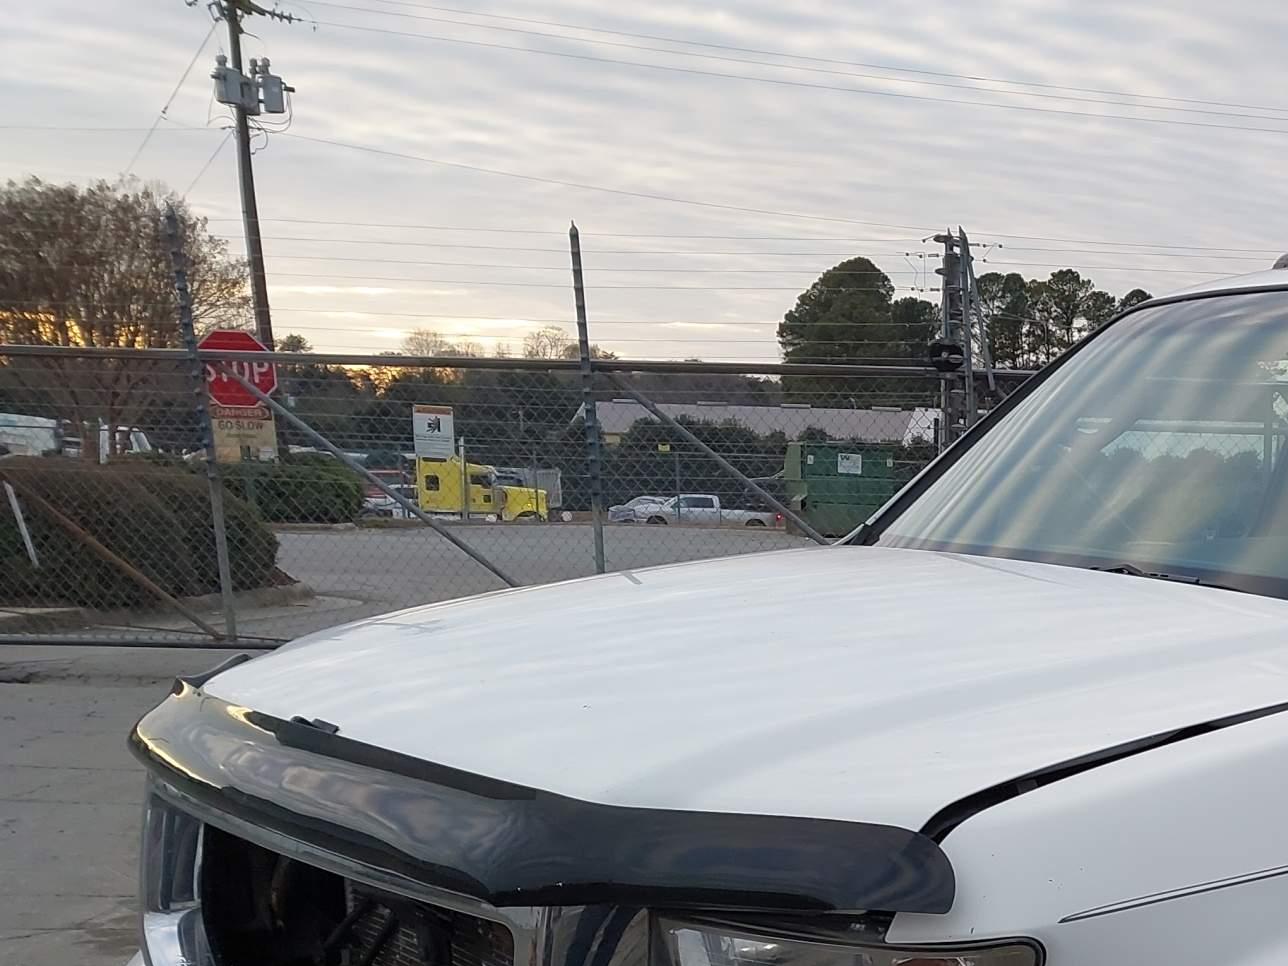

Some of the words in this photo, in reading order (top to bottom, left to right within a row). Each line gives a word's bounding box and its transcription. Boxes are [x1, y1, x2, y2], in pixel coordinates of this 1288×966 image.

[215, 408, 262, 417] DANGER
[218, 420, 233, 430] GO
[235, 420, 264, 430] SLOW
